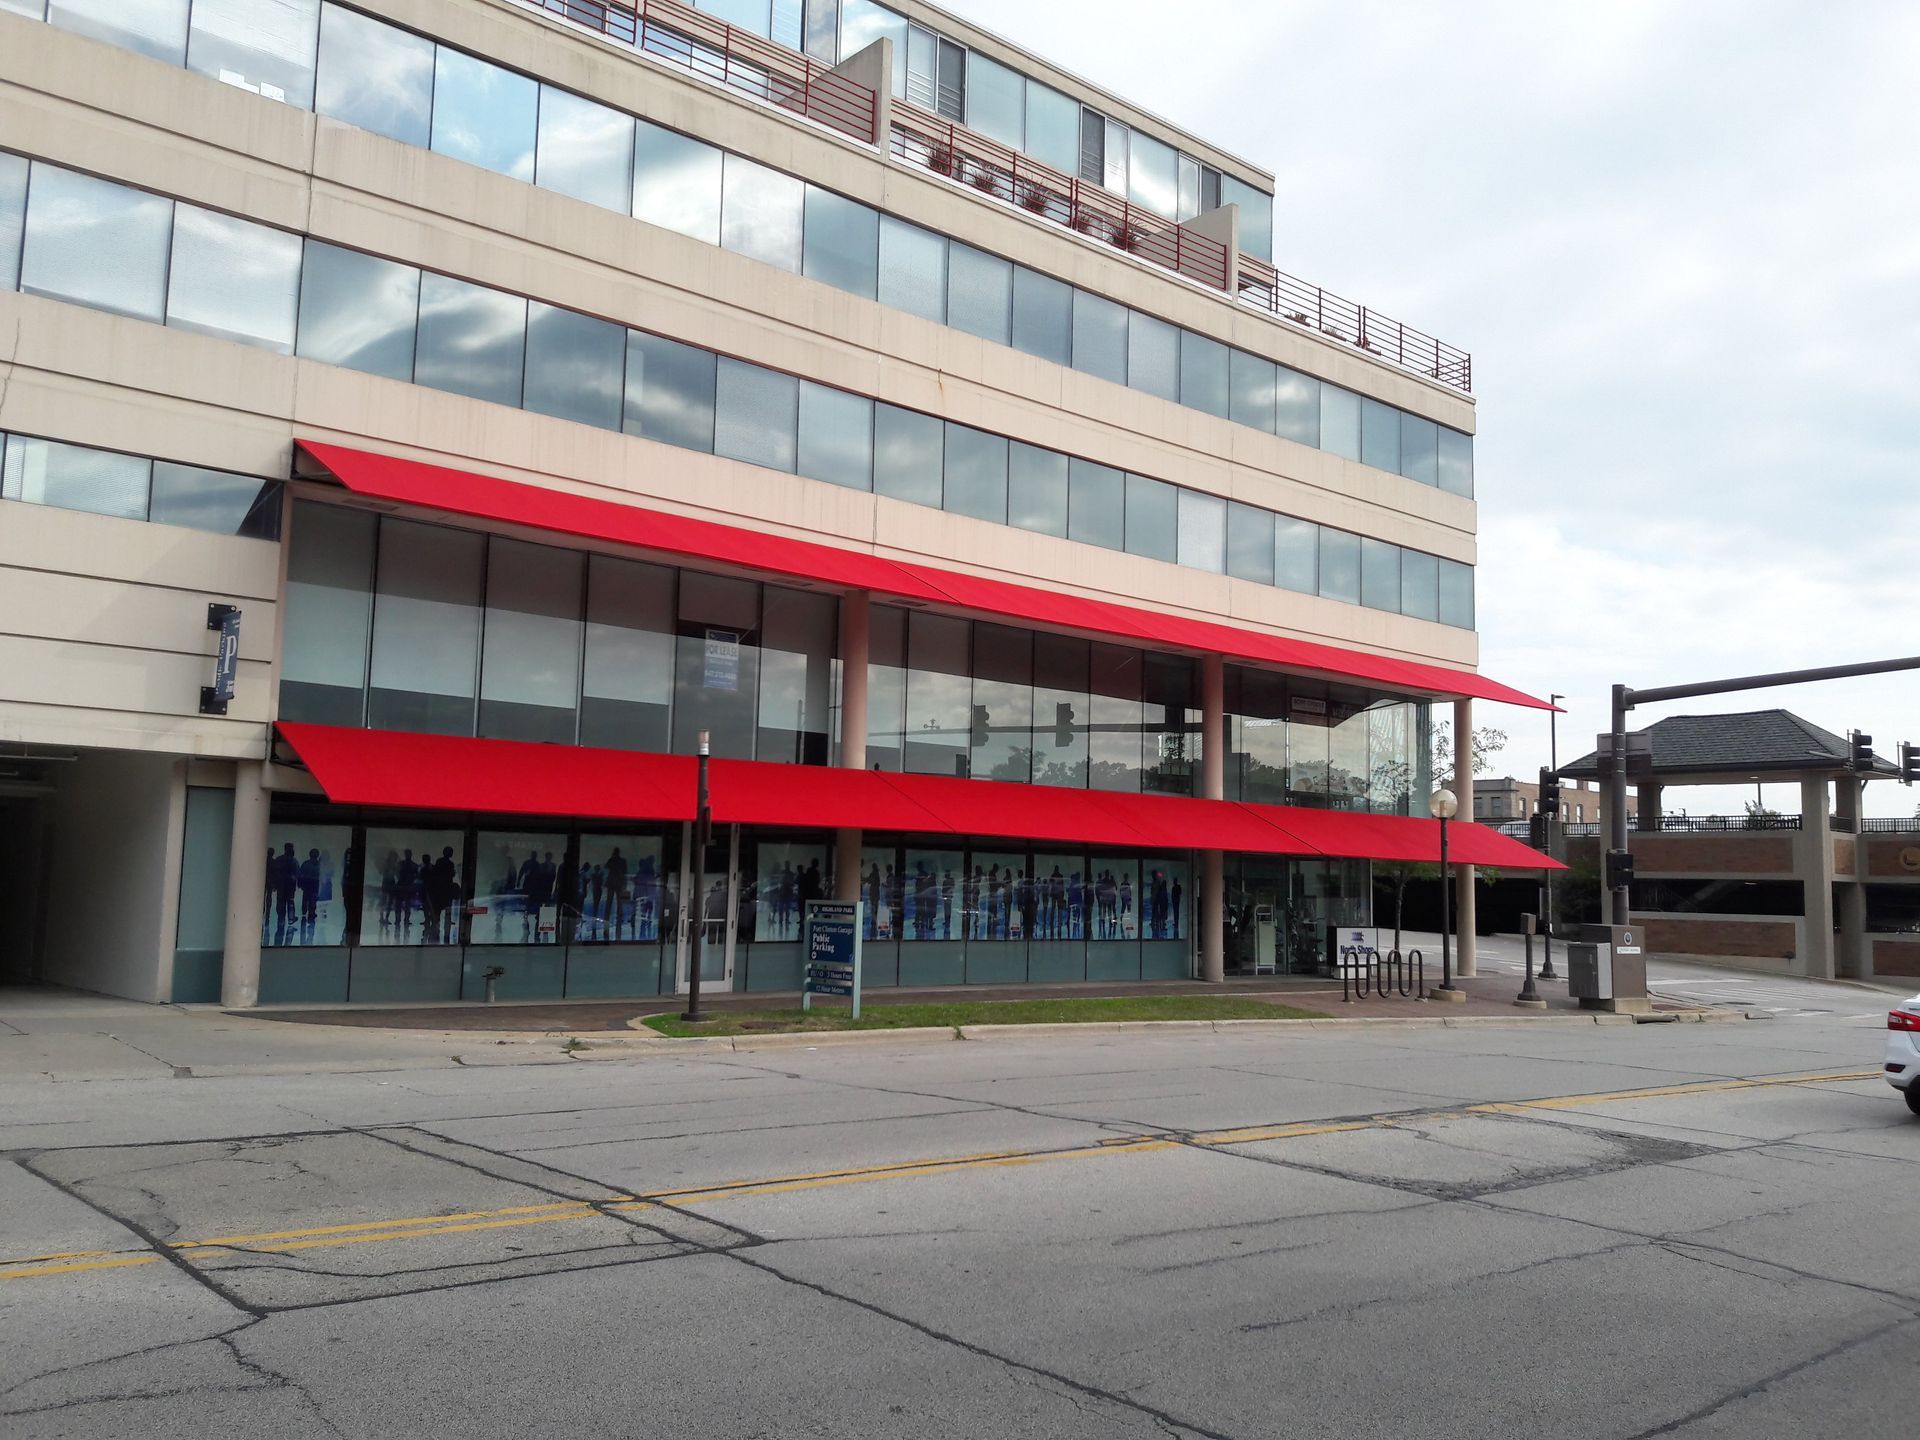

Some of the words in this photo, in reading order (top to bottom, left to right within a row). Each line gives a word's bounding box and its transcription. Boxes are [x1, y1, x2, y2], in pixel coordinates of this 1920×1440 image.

[223, 635, 237, 674] P
[812, 933, 830, 942] Public
[812, 942, 834, 953] Parking
[1340, 945, 1356, 955] North
[1358, 945, 1375, 954] Shore
